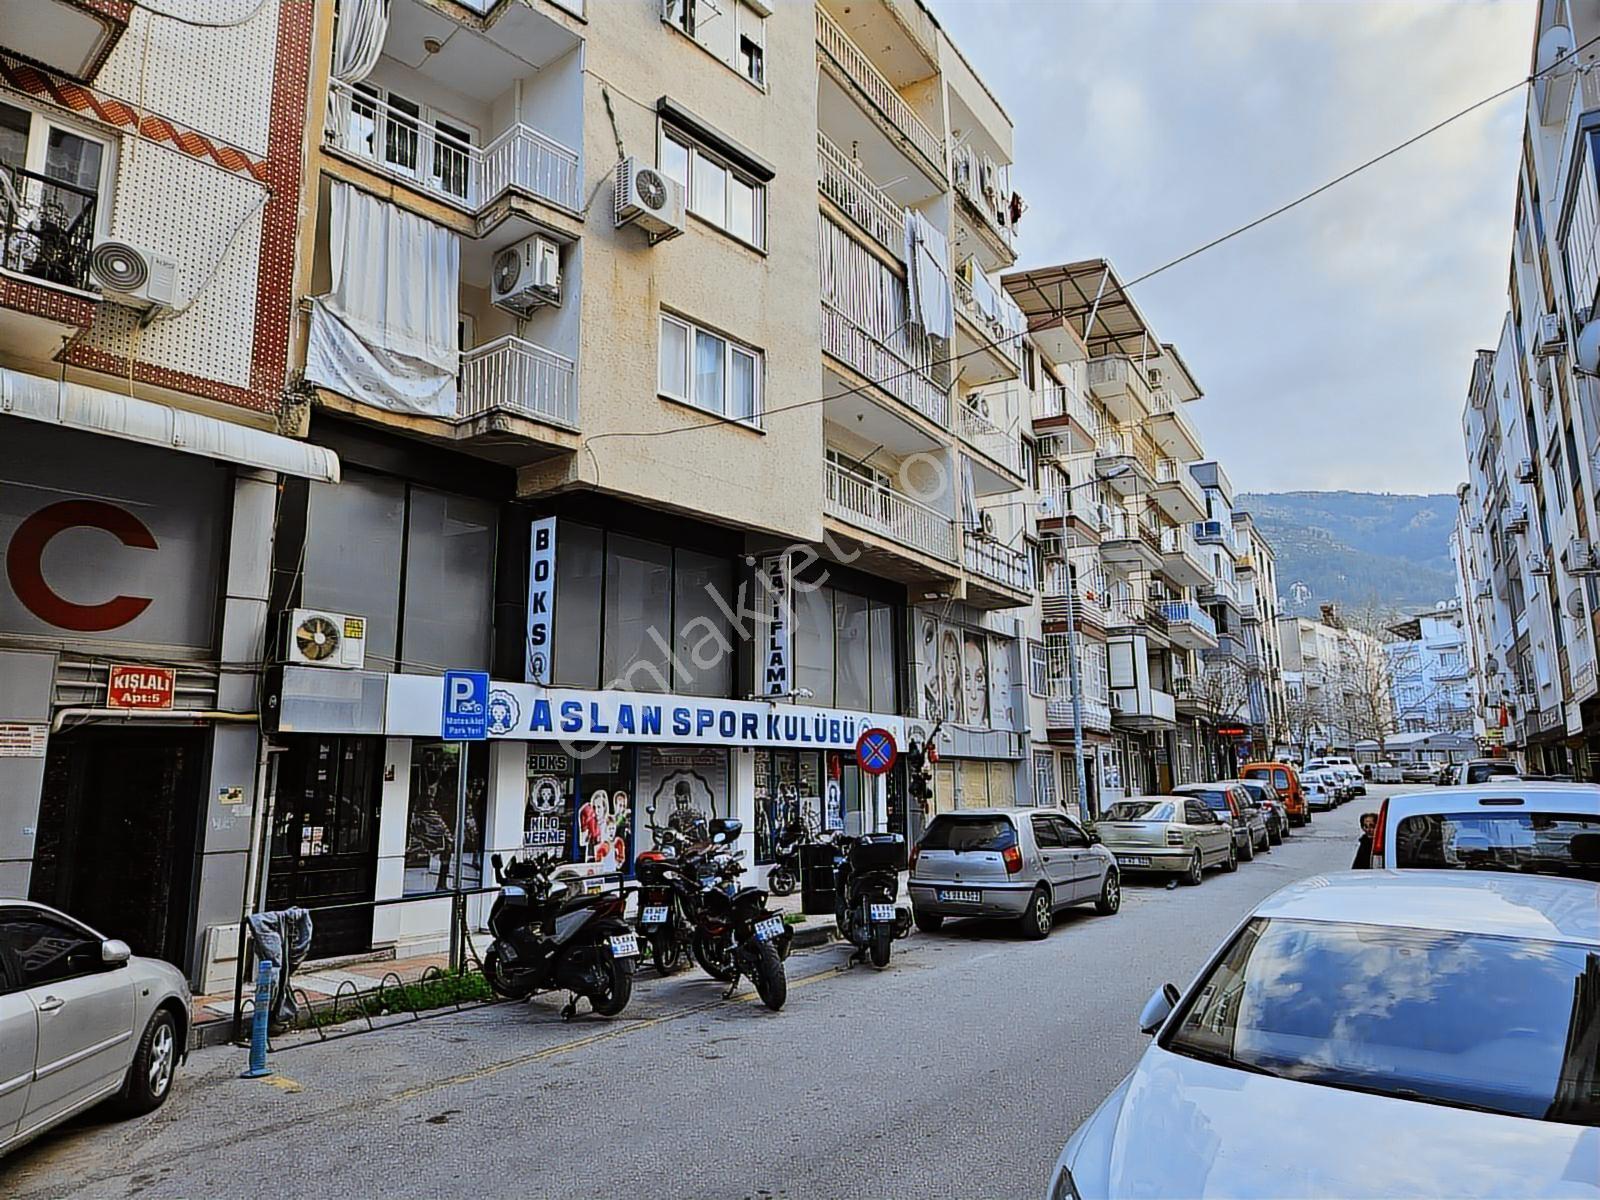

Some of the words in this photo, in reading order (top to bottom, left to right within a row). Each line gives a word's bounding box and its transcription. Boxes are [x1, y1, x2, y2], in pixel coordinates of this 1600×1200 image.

[531, 528, 549, 646] BOKS
[113, 674, 170, 693] KIŞLALI
[450, 677, 474, 713] P
[529, 699, 662, 735] ASLAN
[672, 707, 759, 740] SPOR
[766, 713, 855, 744] KULÜBÜ
[528, 755, 568, 771] BOKS
[524, 830, 566, 844] VERME
